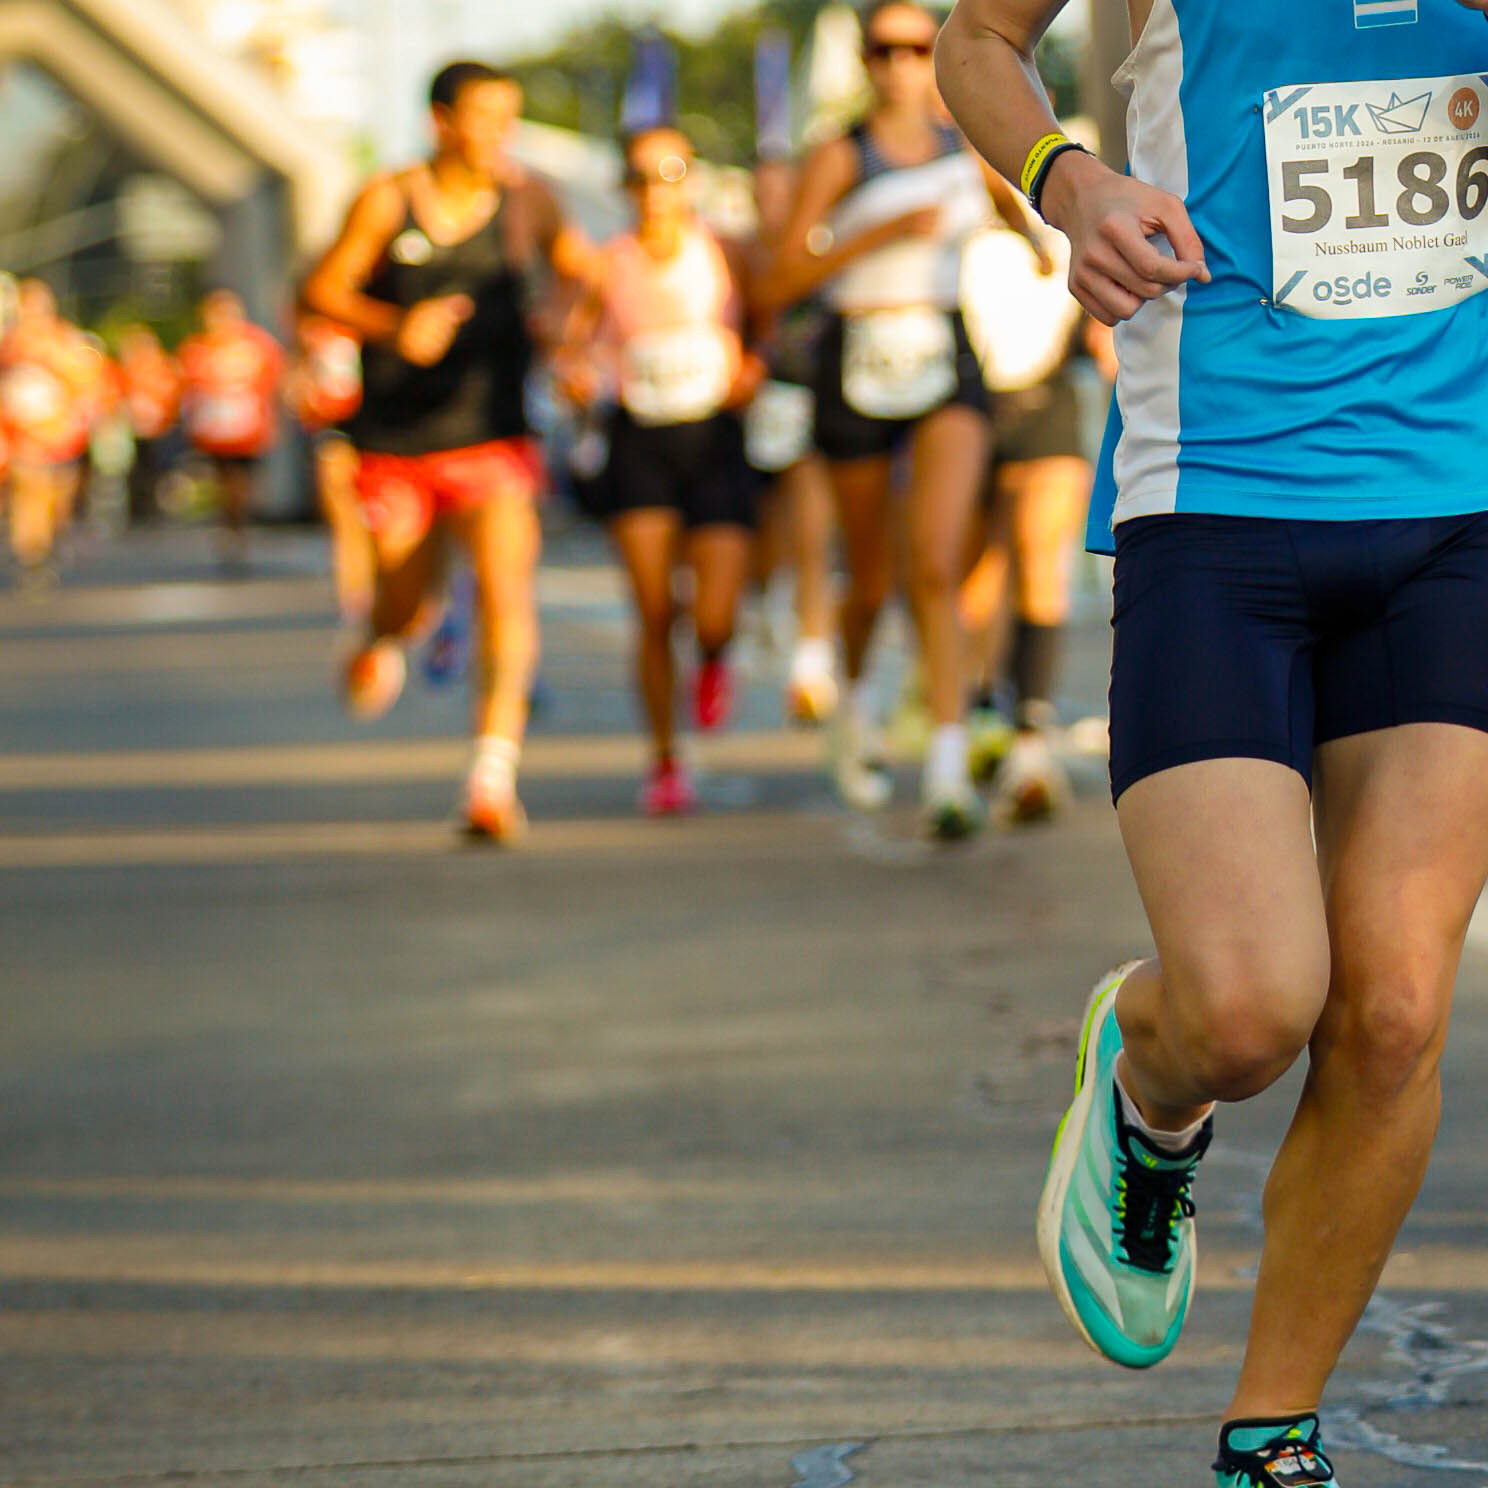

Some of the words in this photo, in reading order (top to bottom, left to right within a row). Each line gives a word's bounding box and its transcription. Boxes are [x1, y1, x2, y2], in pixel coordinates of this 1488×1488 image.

[1293, 104, 1362, 139] 15K
[1454, 100, 1474, 118] 4K
[1314, 240, 1388, 257] Nussbaum
[1392, 234, 1439, 251] Noblet
[1443, 230, 1468, 248] Gael
[1312, 271, 1392, 303] osde
